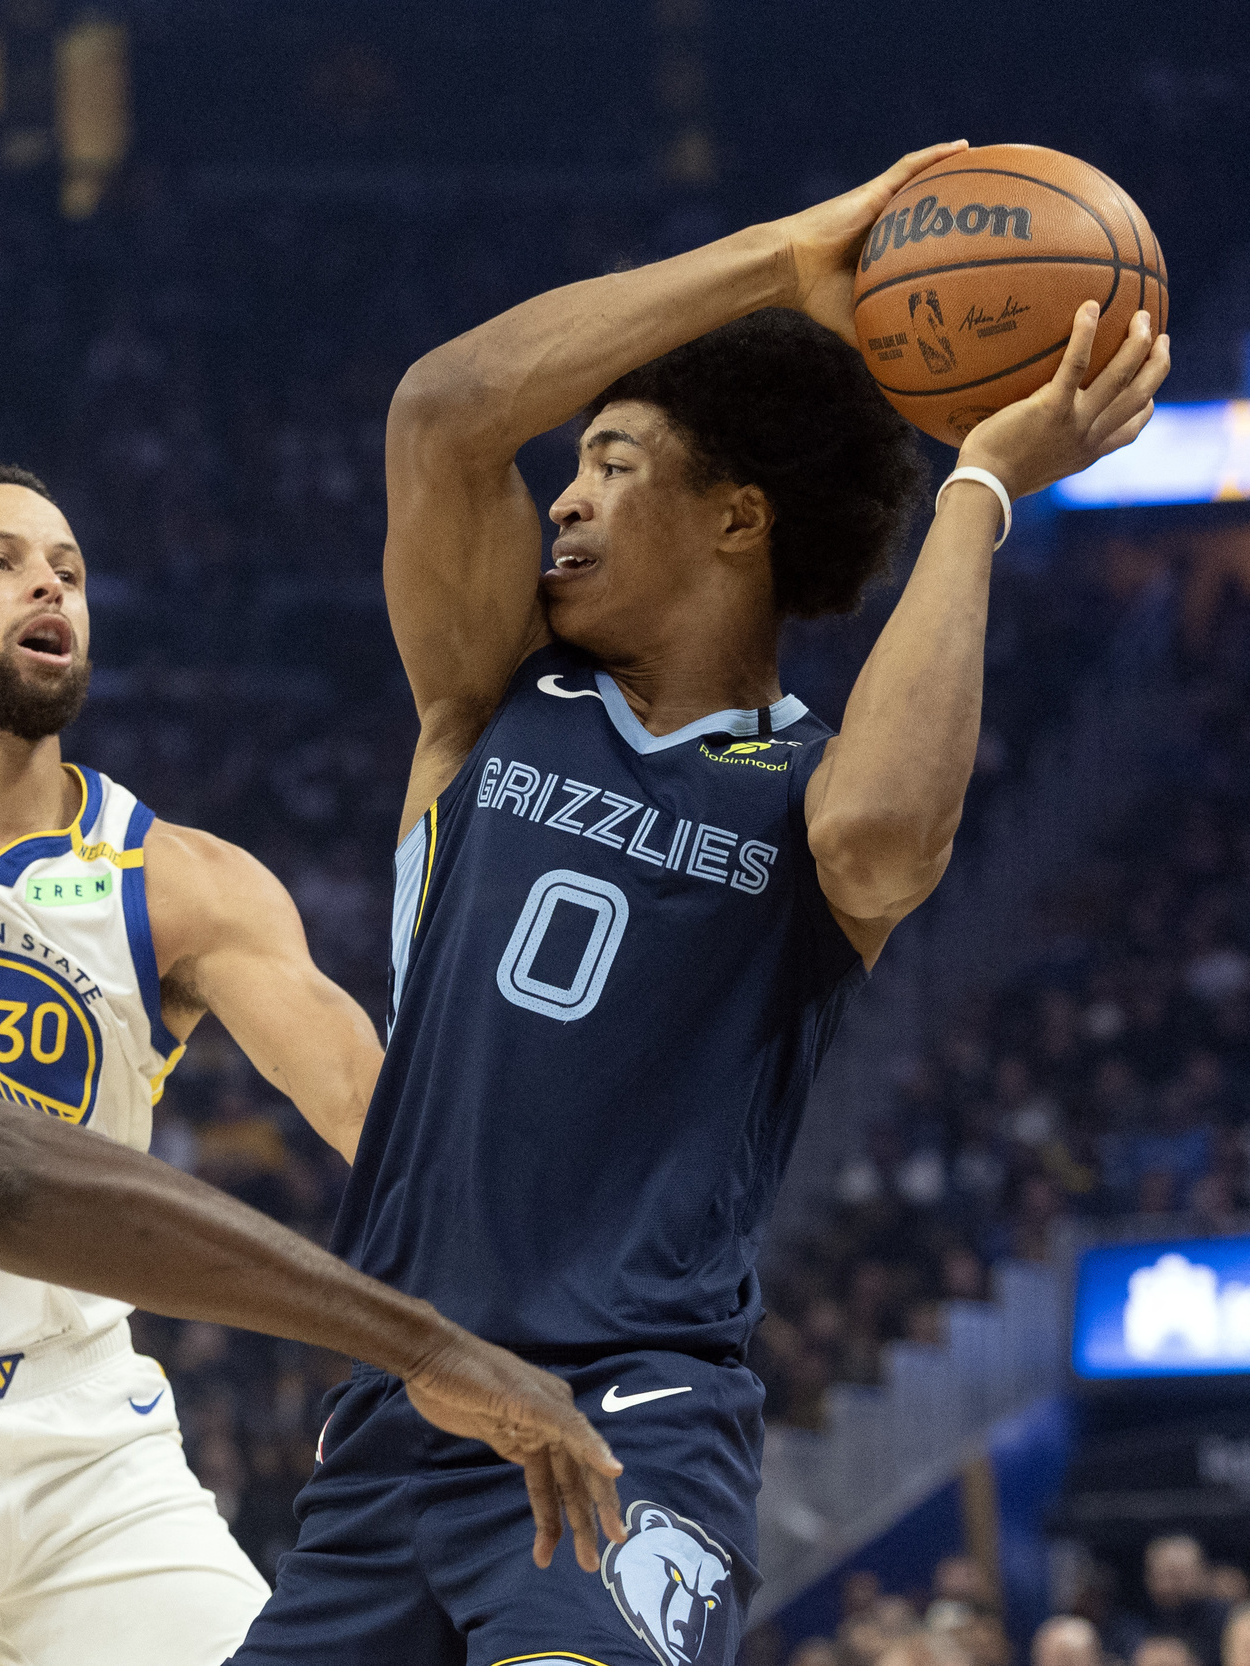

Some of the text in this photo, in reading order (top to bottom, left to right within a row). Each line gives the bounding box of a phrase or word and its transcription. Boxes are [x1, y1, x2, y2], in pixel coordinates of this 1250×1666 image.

[861, 195, 1032, 273] Wilson
[699, 744, 787, 772] Robinhood
[477, 757, 779, 895] GRIZZLIES
[33, 880, 105, 900] IREN
[21, 933, 103, 1005] STATE
[496, 869, 630, 1022] 0
